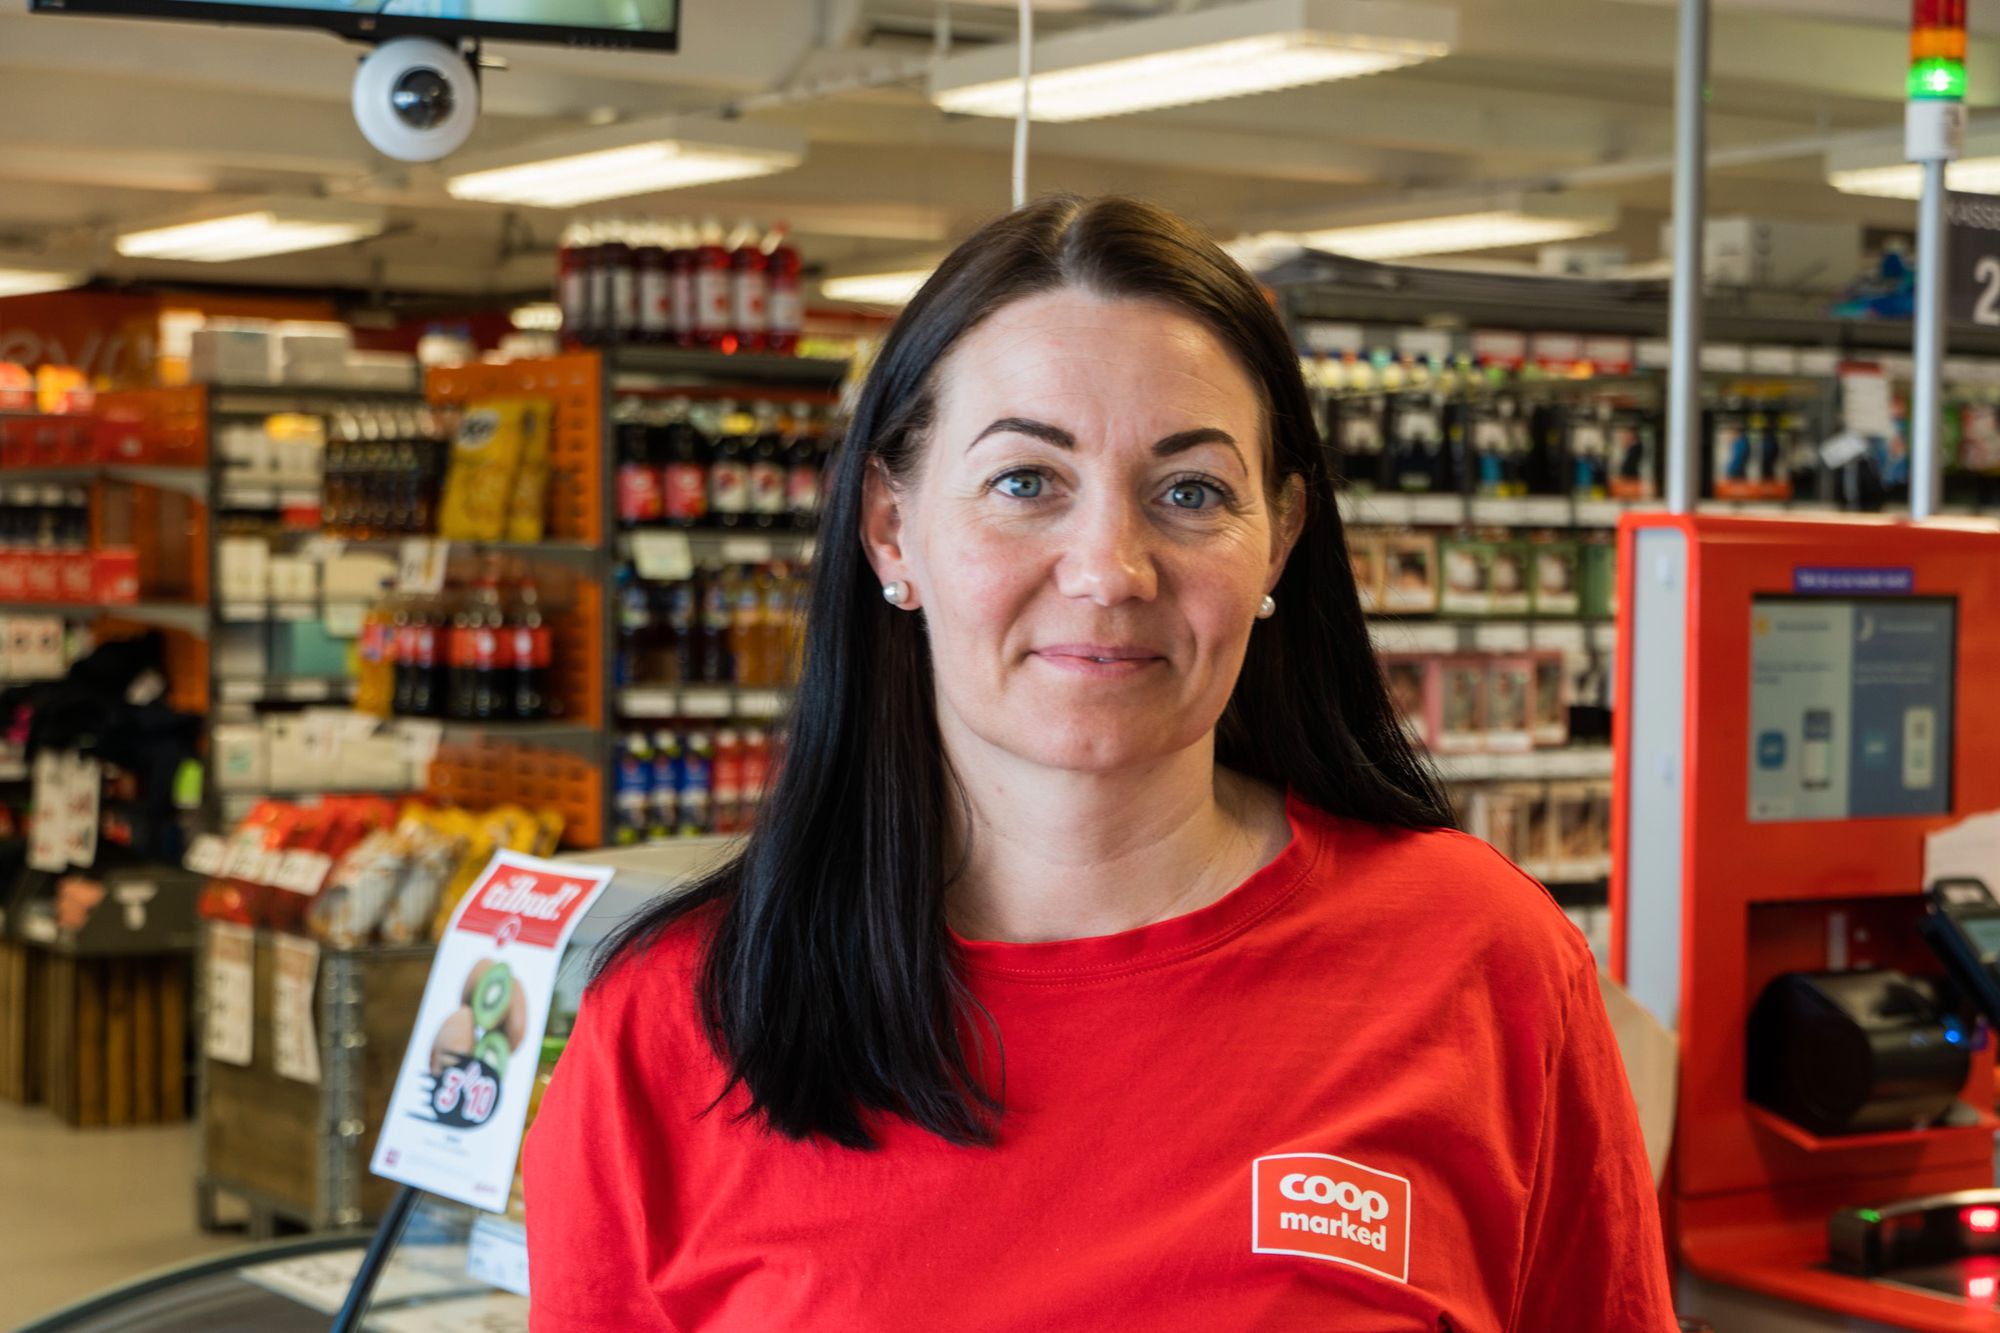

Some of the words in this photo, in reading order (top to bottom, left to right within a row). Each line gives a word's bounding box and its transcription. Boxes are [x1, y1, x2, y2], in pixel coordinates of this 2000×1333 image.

[1973, 257, 2000, 326] 2
[1280, 1173, 1389, 1223] coop
[1280, 1211, 1387, 1251] marked
